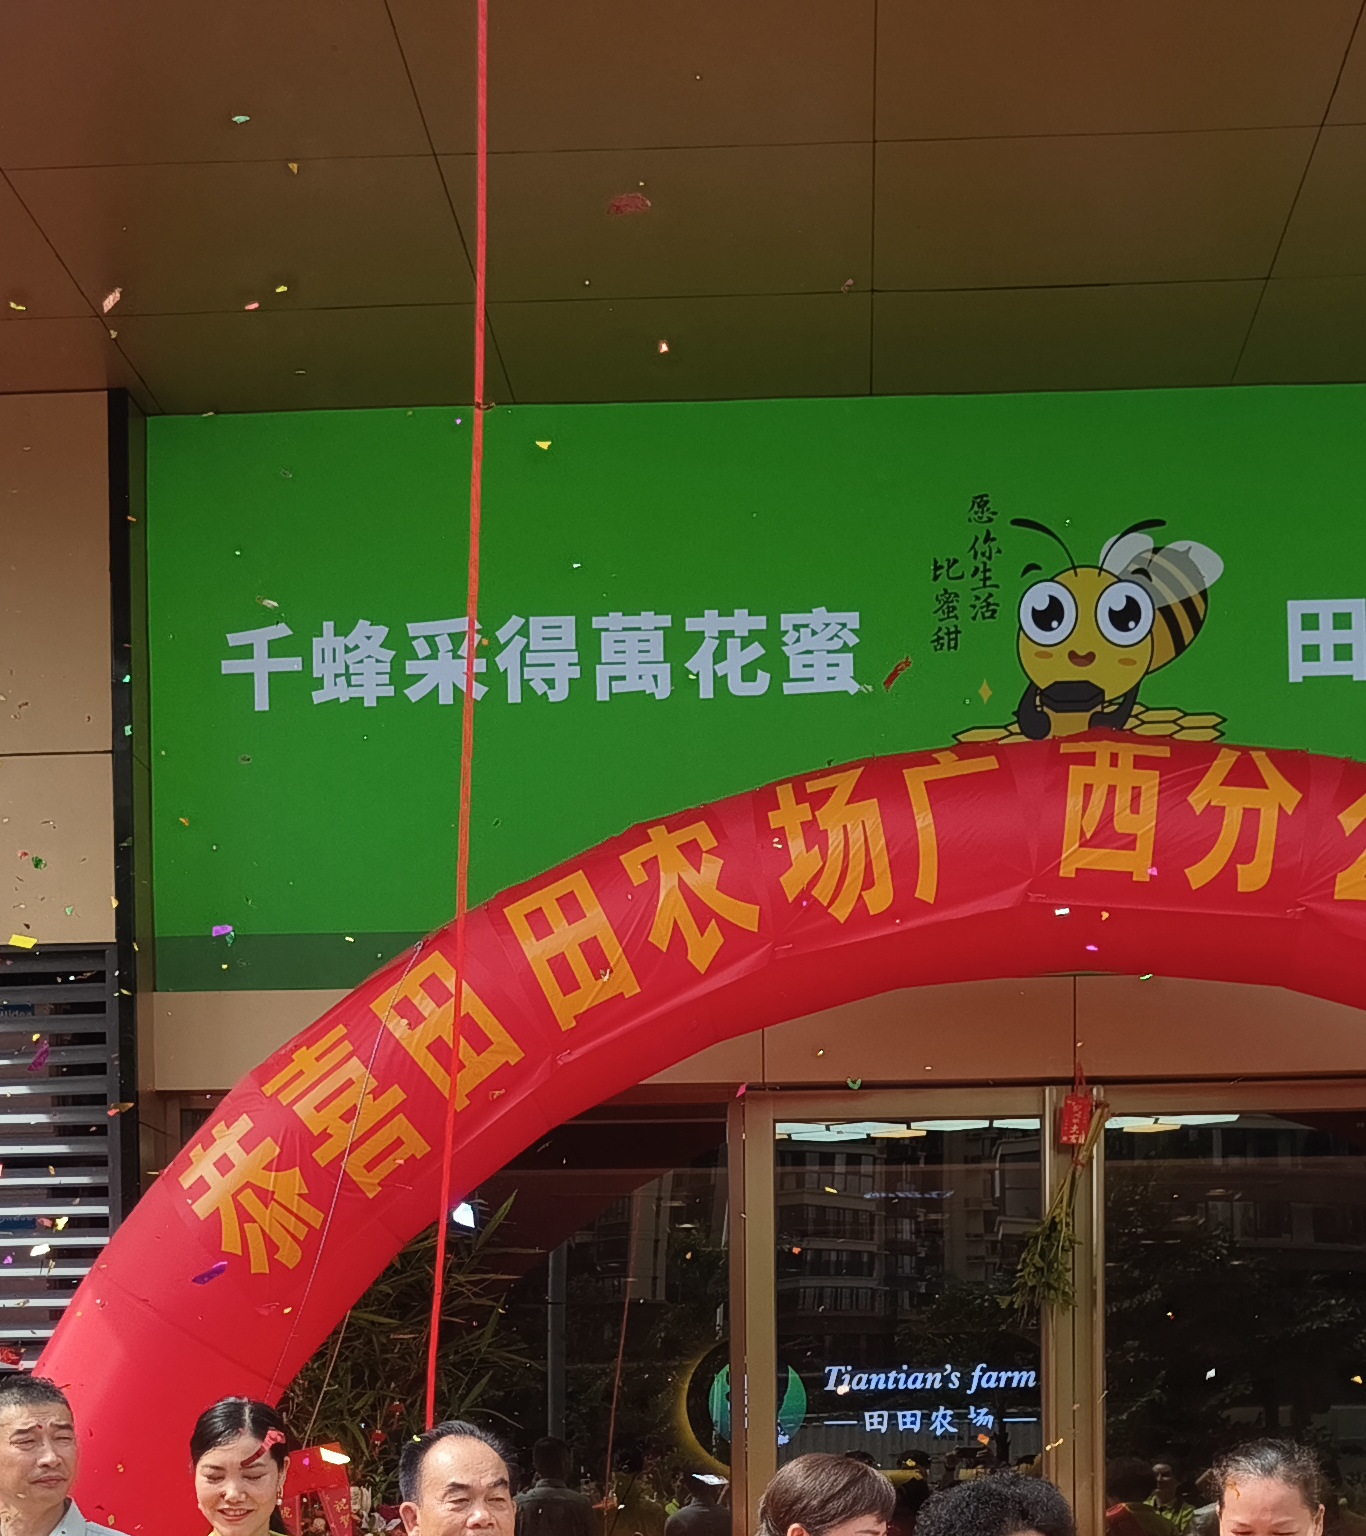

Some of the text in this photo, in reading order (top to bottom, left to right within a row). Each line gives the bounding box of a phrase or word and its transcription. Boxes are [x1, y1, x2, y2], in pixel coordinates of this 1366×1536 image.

[930, 556, 966, 653] 比蜜甜
[967, 493, 1003, 622] 愿你生活
[220, 606, 863, 712] 千蜂采得萬花蜜
[823, 1363, 1038, 1395] Tiantian's farm
[863, 1405, 995, 1437] 田田农场
